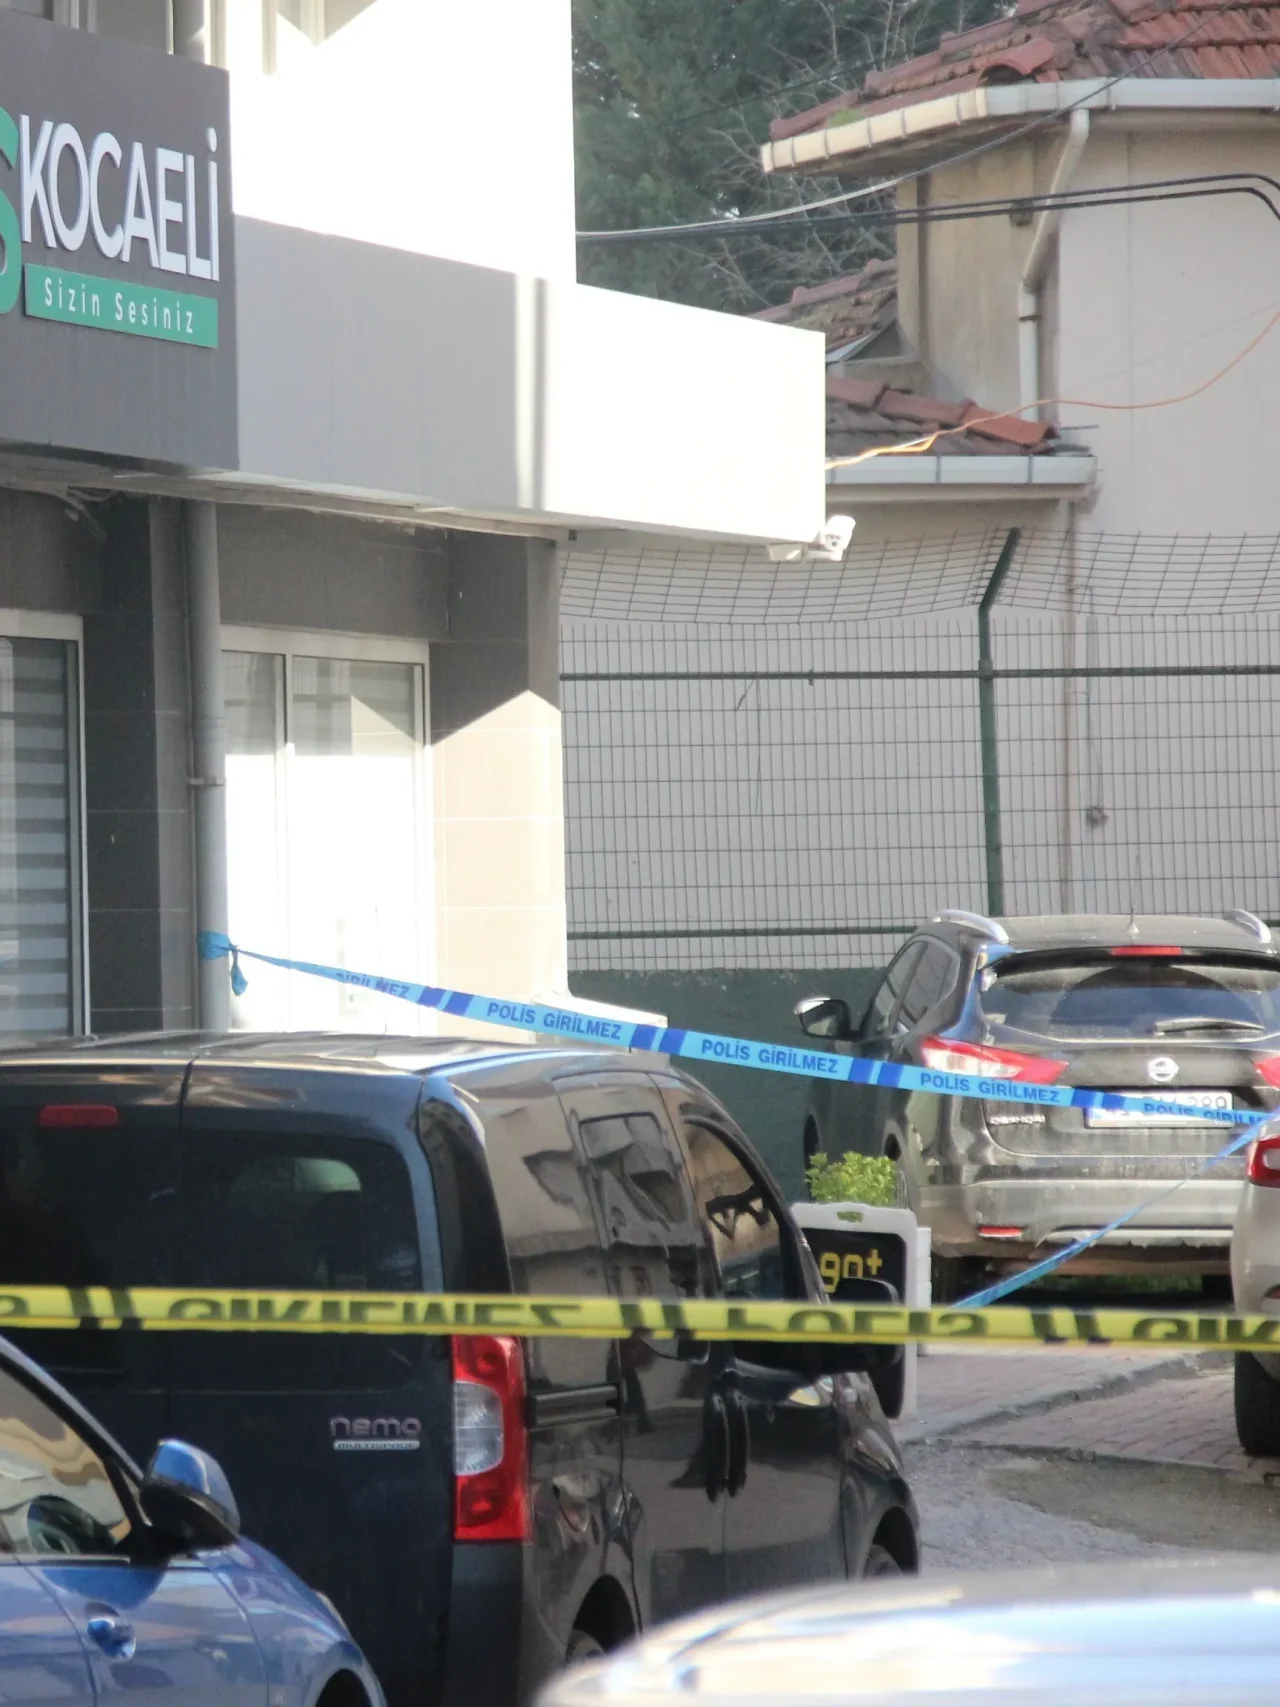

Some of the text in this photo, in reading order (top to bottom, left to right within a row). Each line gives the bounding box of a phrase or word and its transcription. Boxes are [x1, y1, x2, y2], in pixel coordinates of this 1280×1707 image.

[20, 114, 220, 281] KOCAELİ
[44, 277, 194, 334] Sizin Sesiniz
[487, 1002, 622, 1041] POLİS GİRİLMEZ
[702, 1039, 838, 1074] POLİS GİRİLMEZ
[920, 1073, 1061, 1103] POLİS GİRİLMEZ
[329, 1416, 422, 1437] nemo
